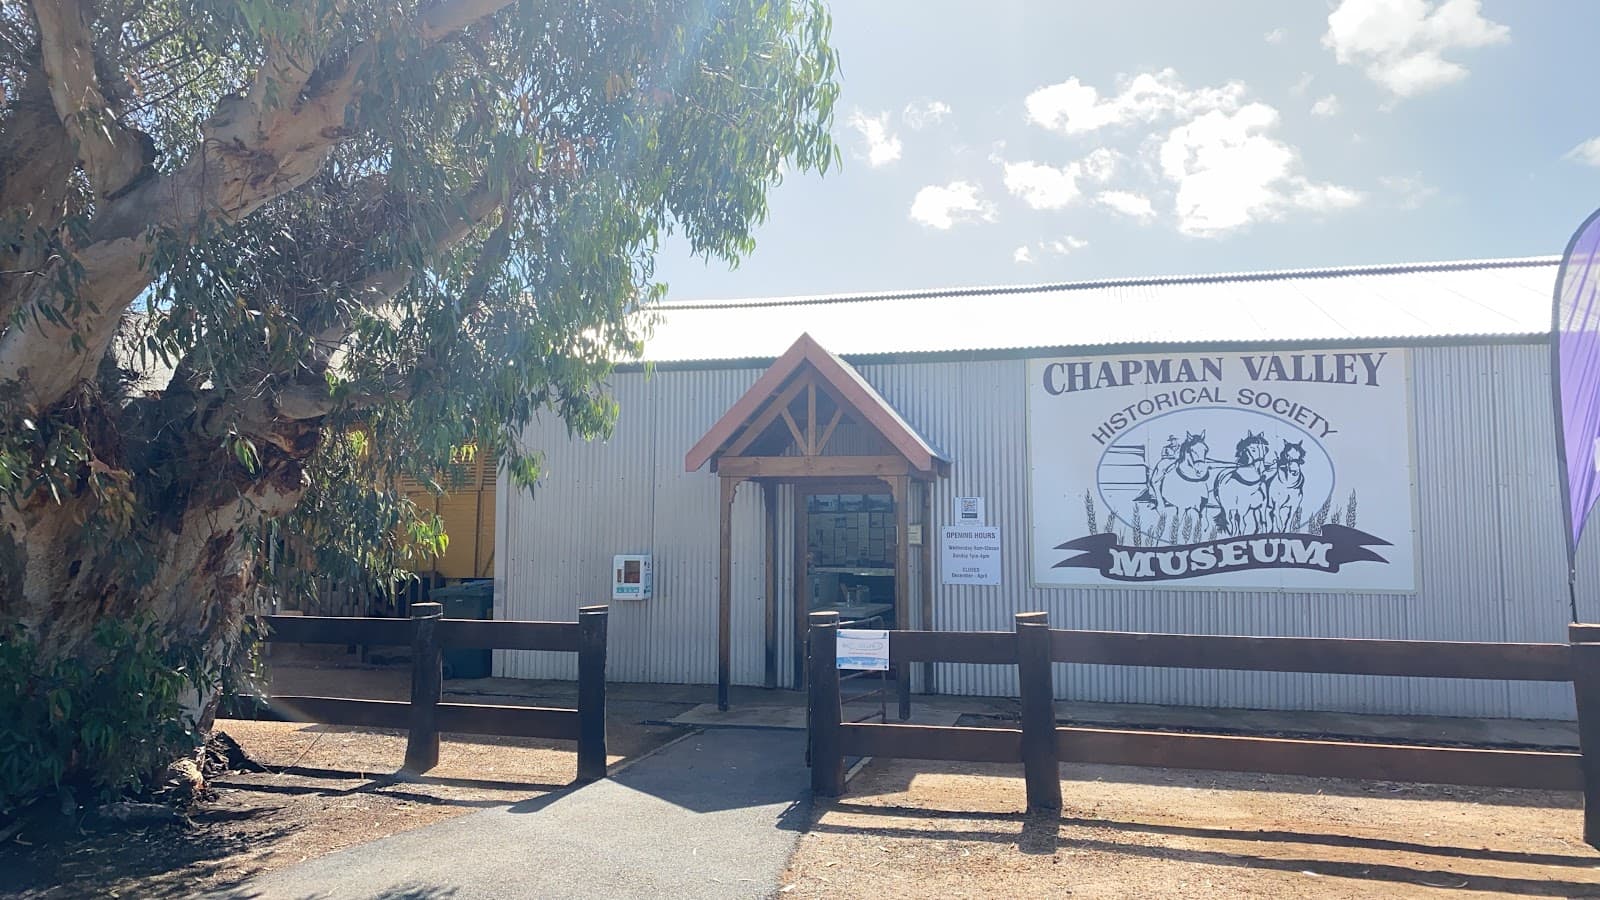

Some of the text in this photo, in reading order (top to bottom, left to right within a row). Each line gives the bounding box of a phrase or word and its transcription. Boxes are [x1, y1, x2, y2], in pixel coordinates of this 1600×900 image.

[1043, 352, 1387, 396] CHAPMAN VALLEY
[1091, 387, 1338, 445] HISTORICAL SOCIETY
[1108, 539, 1332, 578] MUSEUM
